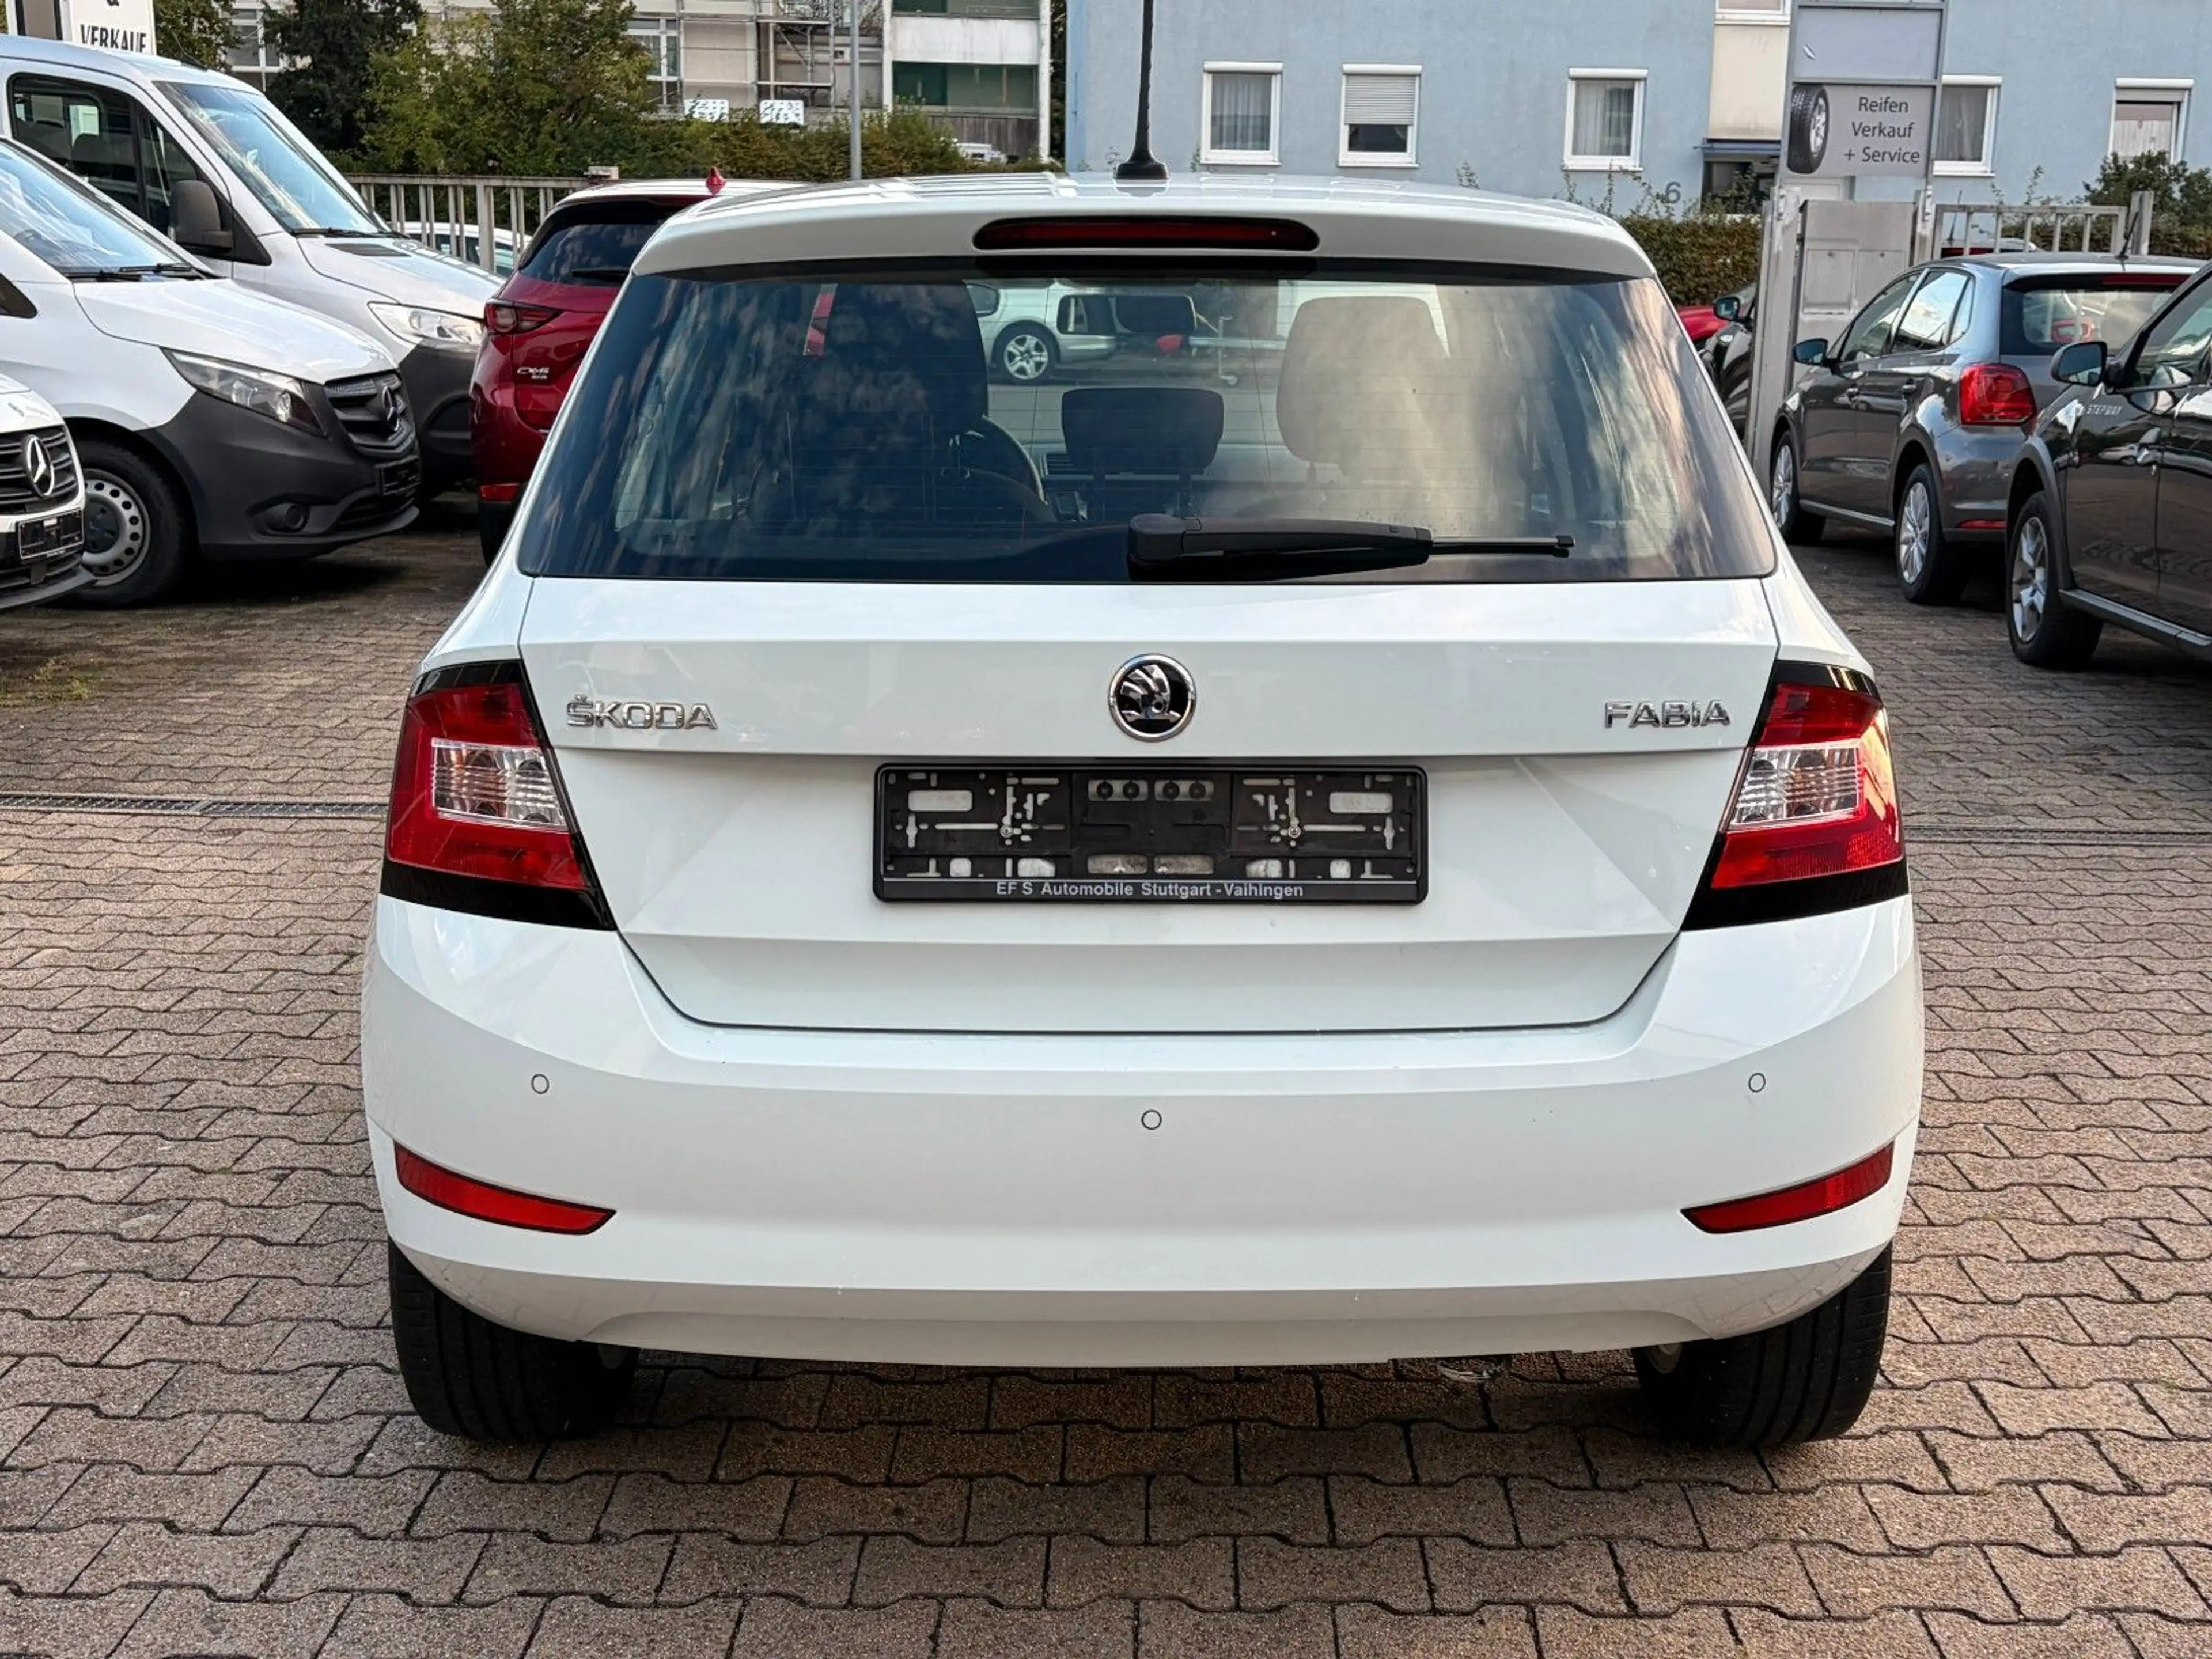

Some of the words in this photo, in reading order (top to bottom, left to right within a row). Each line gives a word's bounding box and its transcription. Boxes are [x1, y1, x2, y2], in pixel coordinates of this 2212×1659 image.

[80, 24, 146, 52] VERKAUF
[1858, 96, 1909, 113] Reifen
[1851, 122, 1914, 138] Verkauf
[1862, 146, 1920, 163] Service
[1665, 181, 1681, 204] 6
[567, 694, 718, 730] ŠKODA
[1605, 700, 1730, 728] FABIA
[1041, 882, 1134, 896] Automobile
